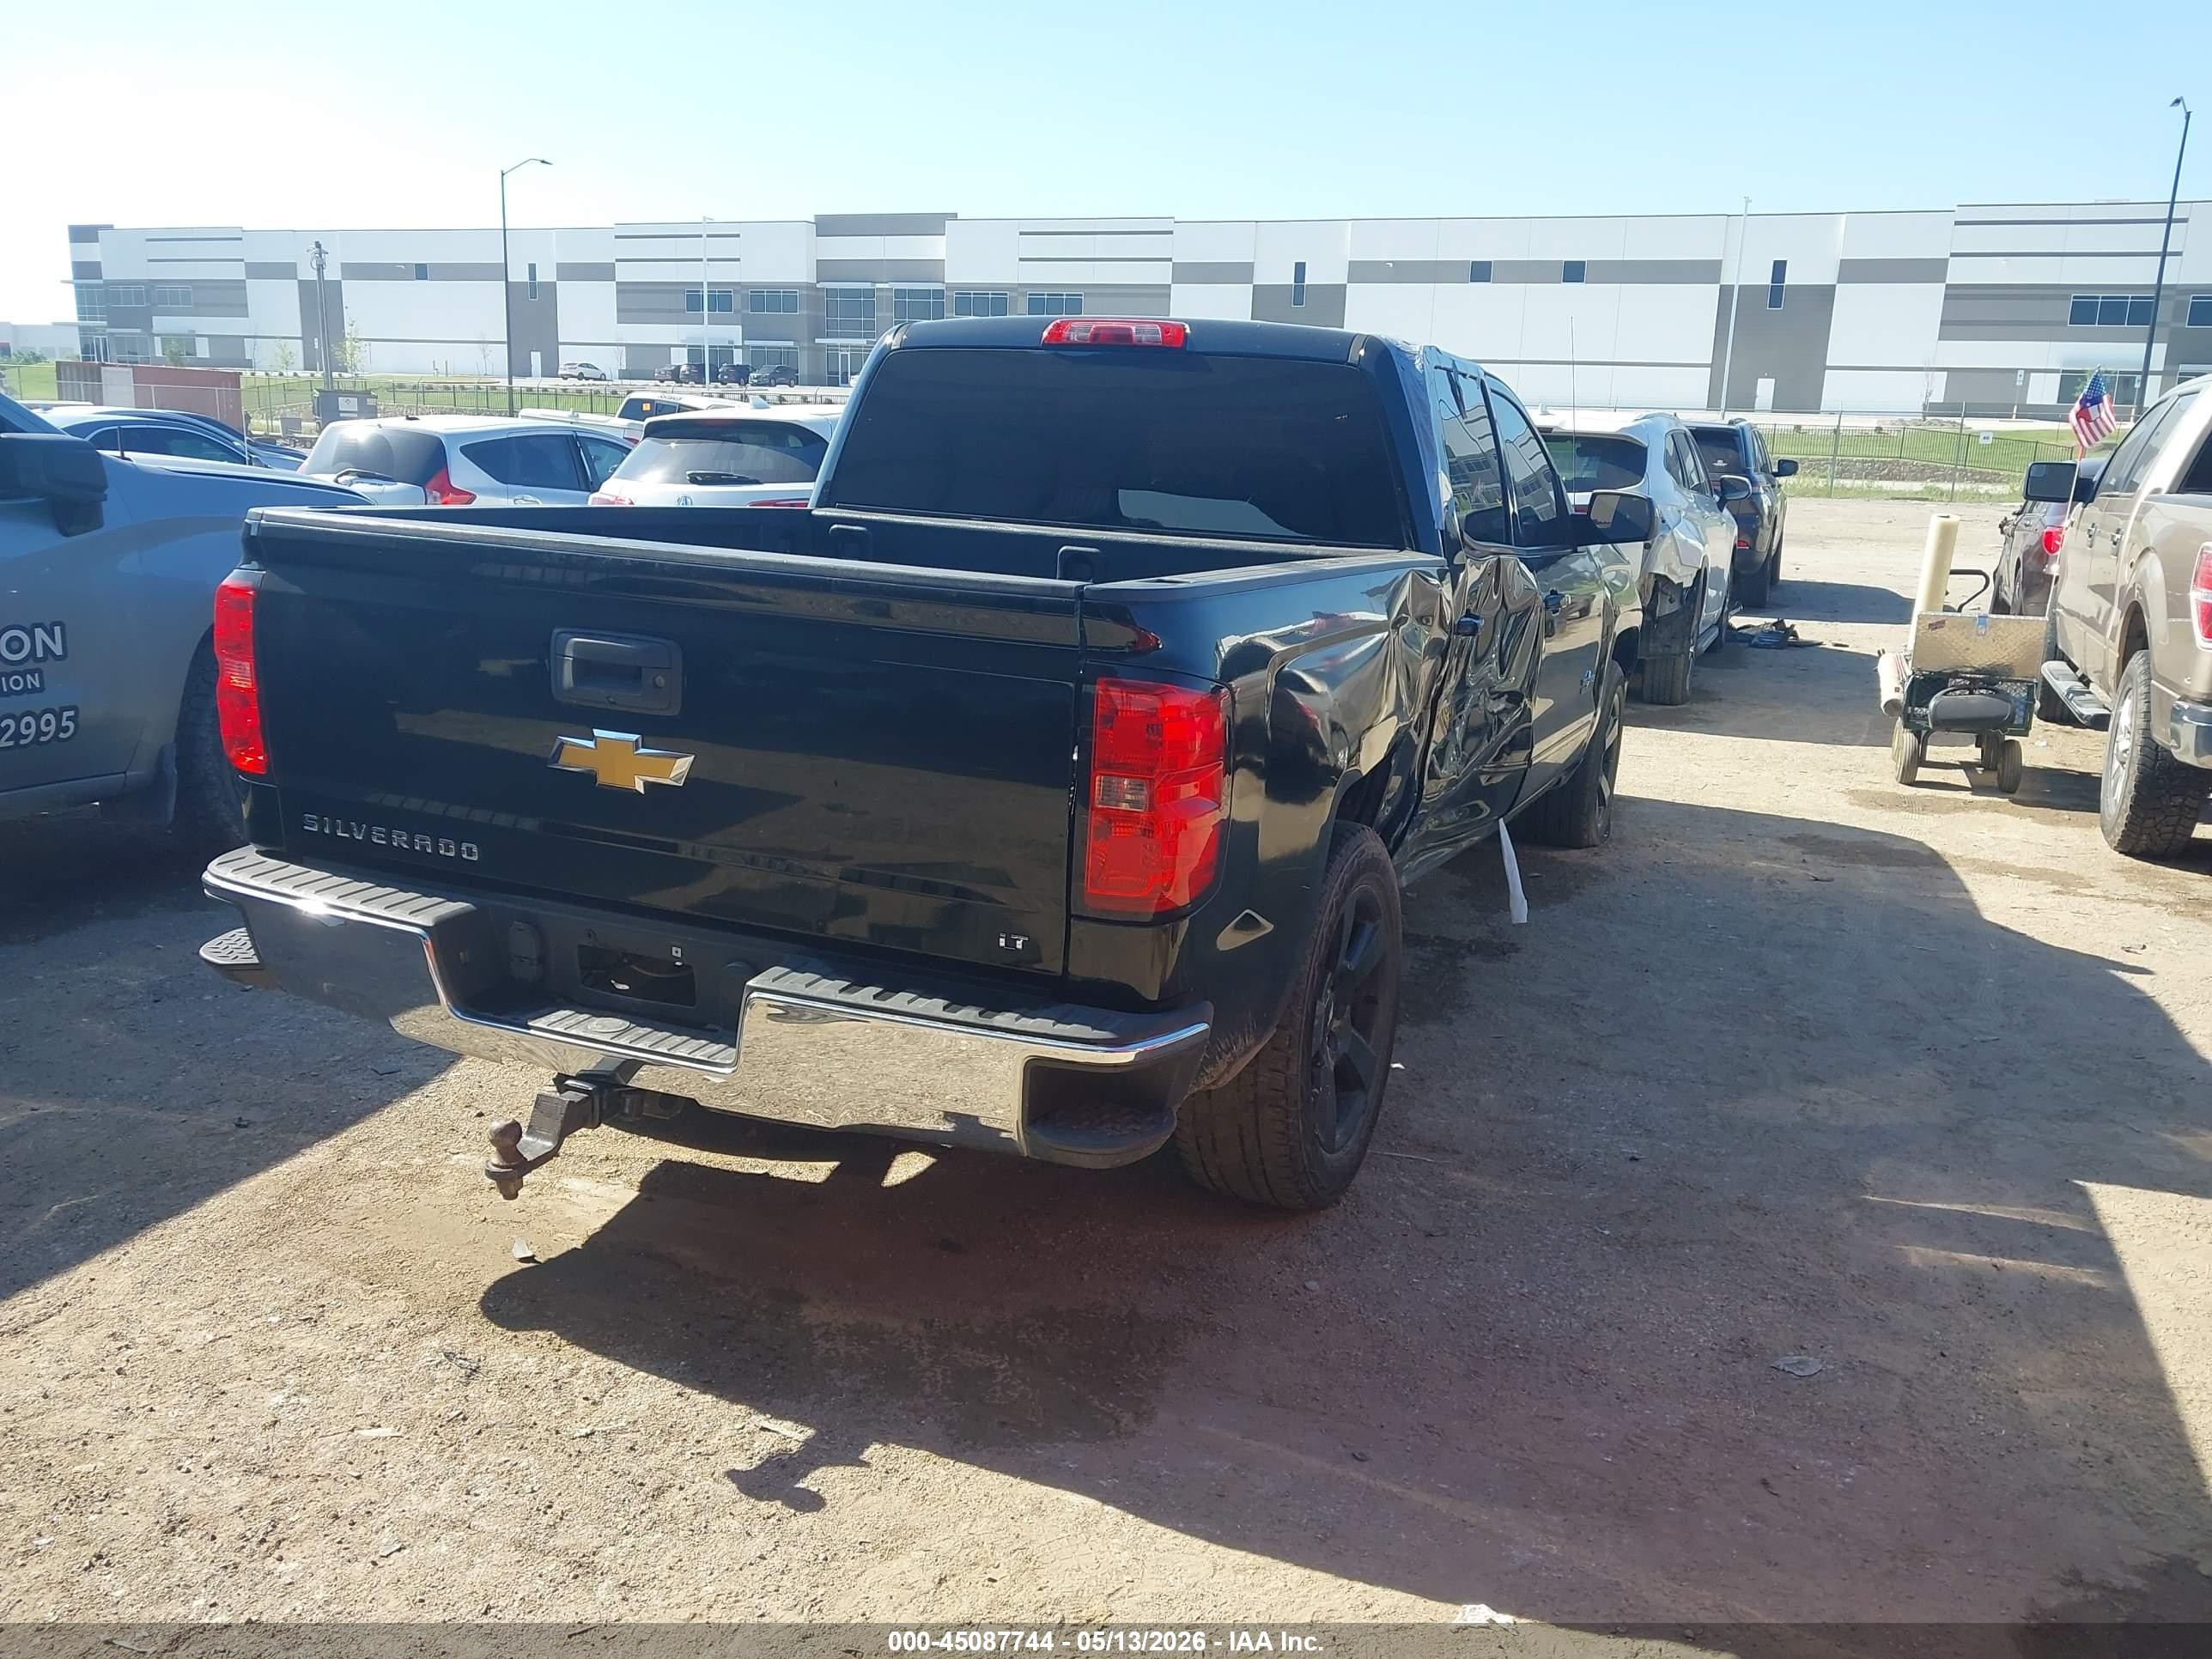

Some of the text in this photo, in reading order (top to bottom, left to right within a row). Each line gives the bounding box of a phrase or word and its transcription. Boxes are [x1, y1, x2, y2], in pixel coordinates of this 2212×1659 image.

[0, 625, 63, 661] ON
[1, 672, 40, 692] ION
[0, 710, 76, 748] 2995
[302, 813, 479, 861] SILVERADO
[999, 933, 1030, 951] LT
